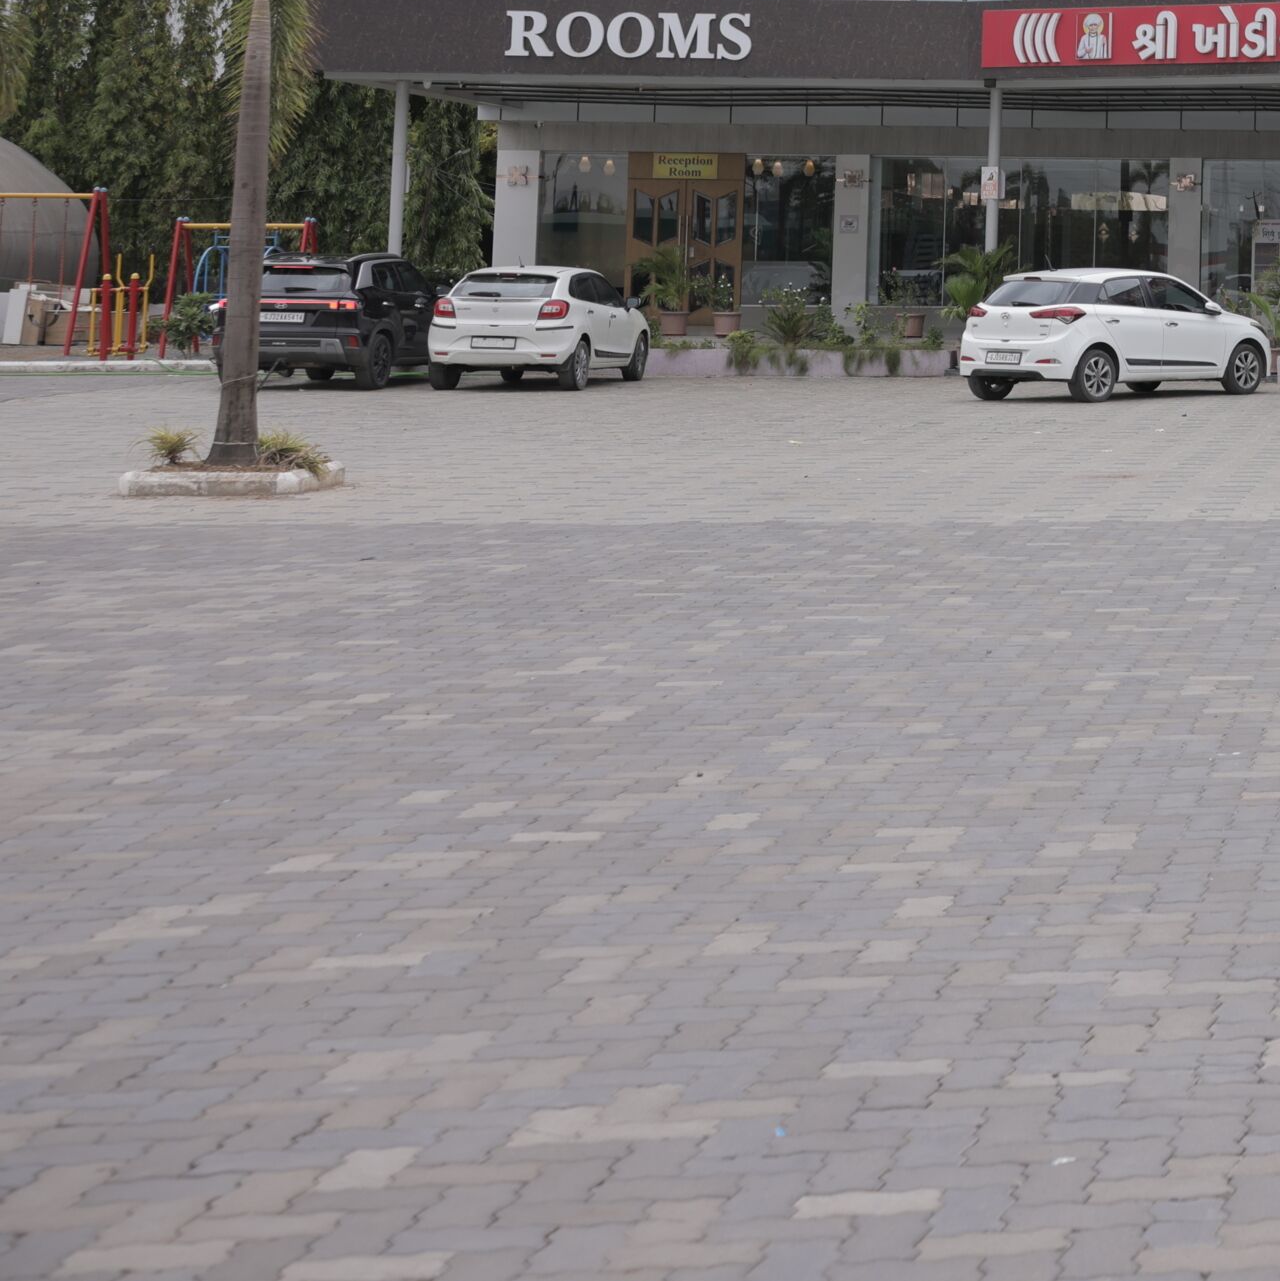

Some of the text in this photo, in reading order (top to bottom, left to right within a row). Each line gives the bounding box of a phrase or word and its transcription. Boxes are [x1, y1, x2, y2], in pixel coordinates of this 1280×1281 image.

[504, 10, 753, 61] ROOMS
[1130, 9, 1178, 60] શ્રી
[658, 155, 713, 168] Reception
[669, 167, 702, 177] Room
